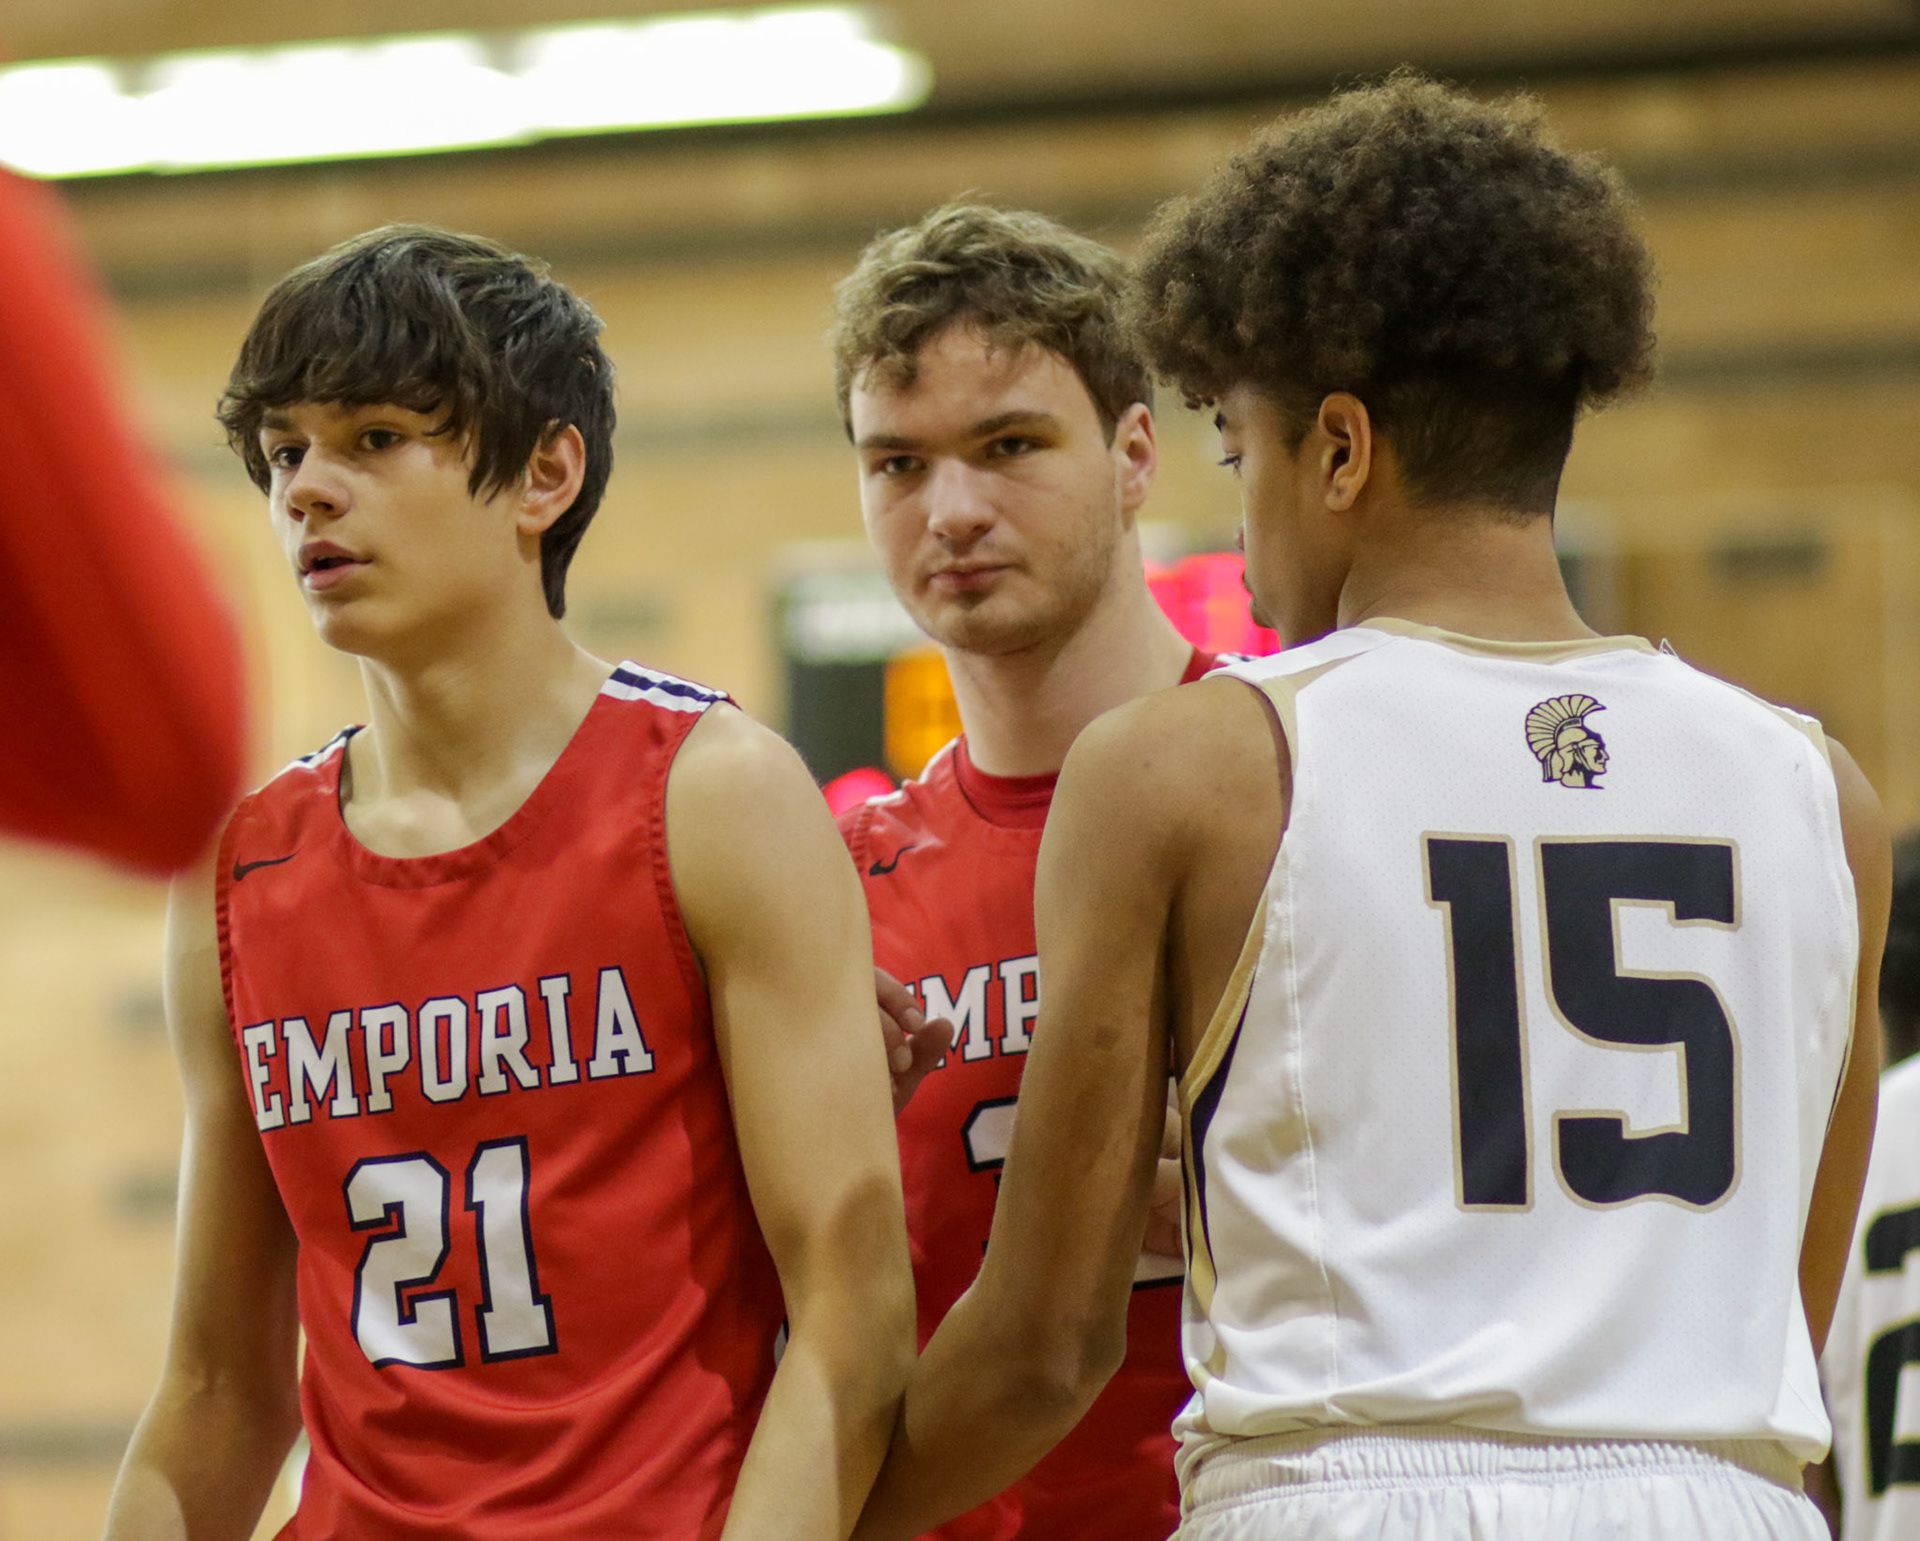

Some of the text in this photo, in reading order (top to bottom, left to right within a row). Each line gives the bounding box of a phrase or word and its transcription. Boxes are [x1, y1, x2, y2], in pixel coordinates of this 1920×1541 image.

[242, 965, 656, 1132] EMPORIA
[1419, 830, 1743, 1213] 15
[342, 1135, 559, 1371] 21
